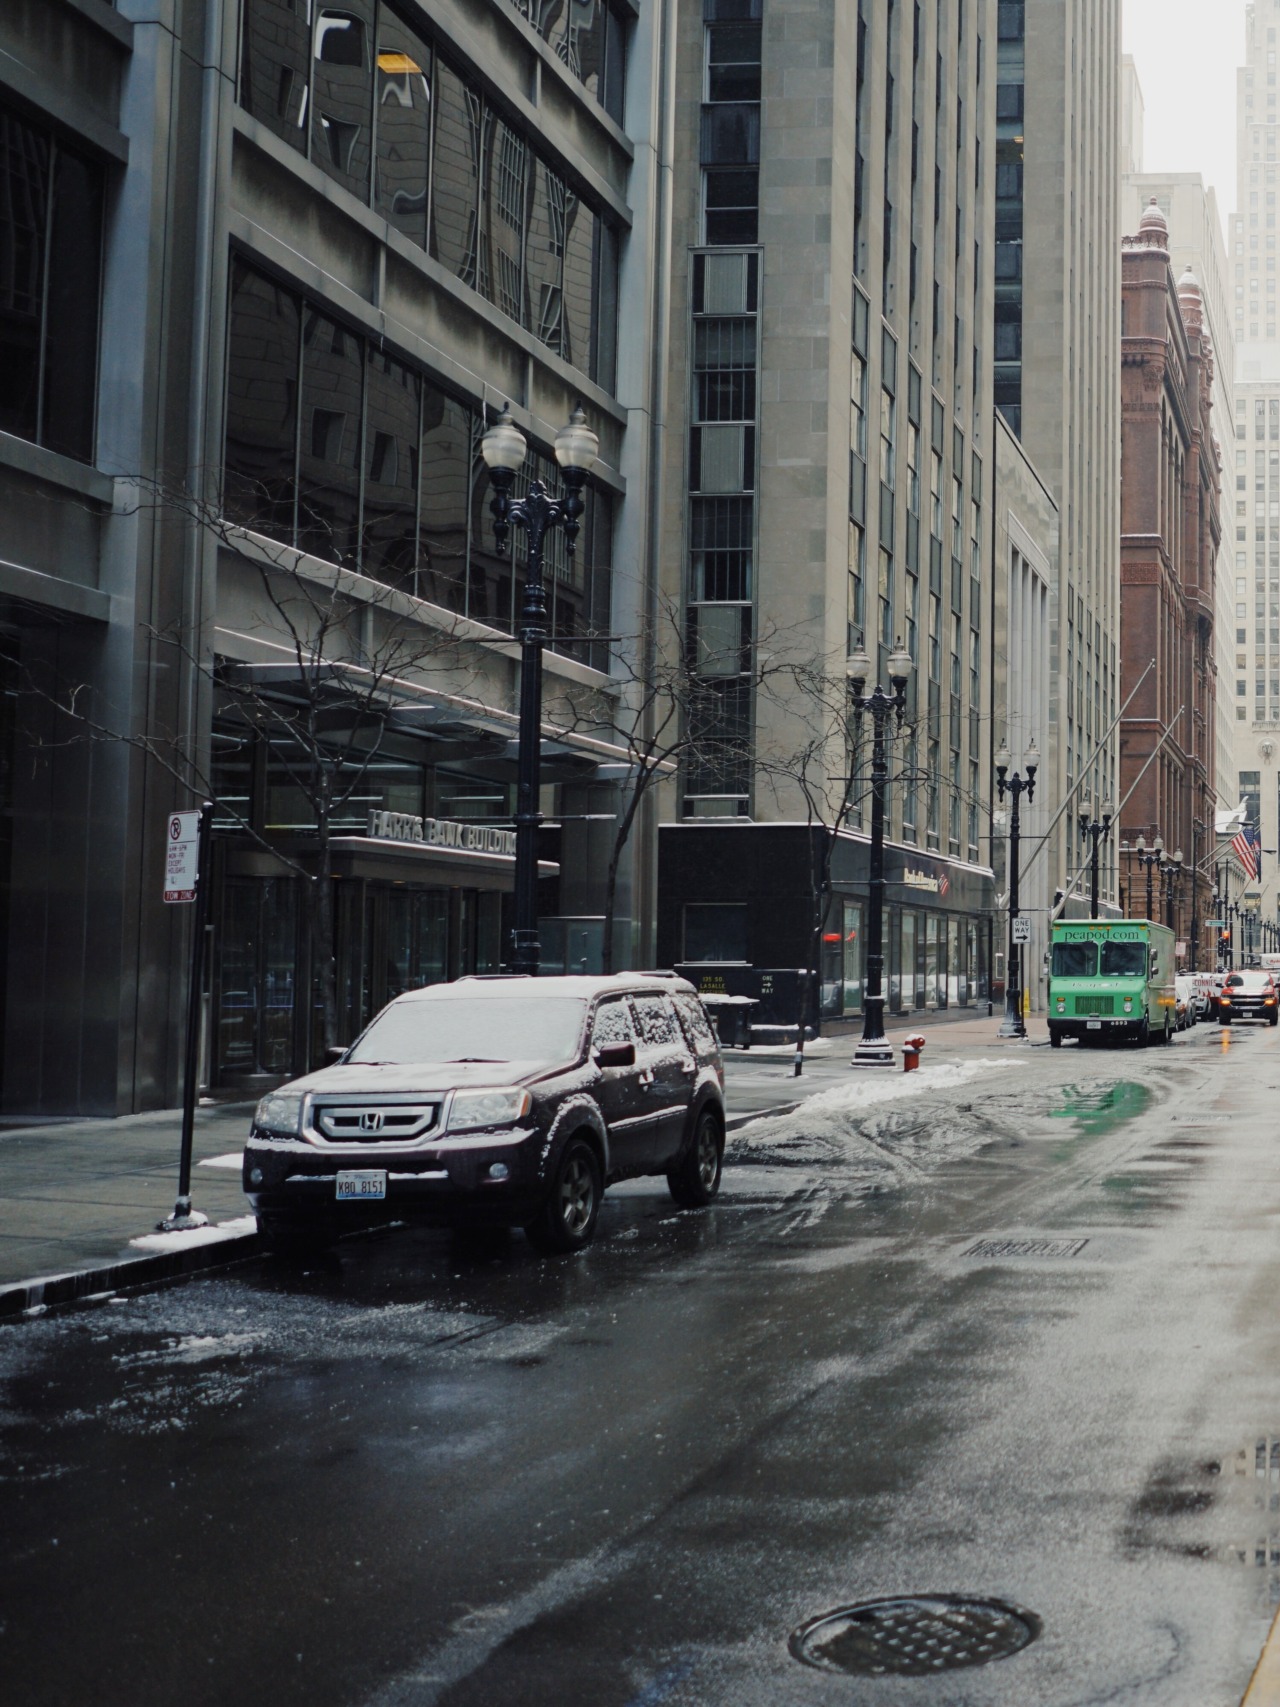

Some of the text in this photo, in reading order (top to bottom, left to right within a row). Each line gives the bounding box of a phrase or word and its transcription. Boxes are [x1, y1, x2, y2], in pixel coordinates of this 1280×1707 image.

[366, 809, 517, 854] HARRIS BANK BUILDIN
[166, 890, 193, 900] TOW ZONE
[1064, 929, 1140, 942] peapod.com
[338, 1180, 383, 1194] K80 8151
